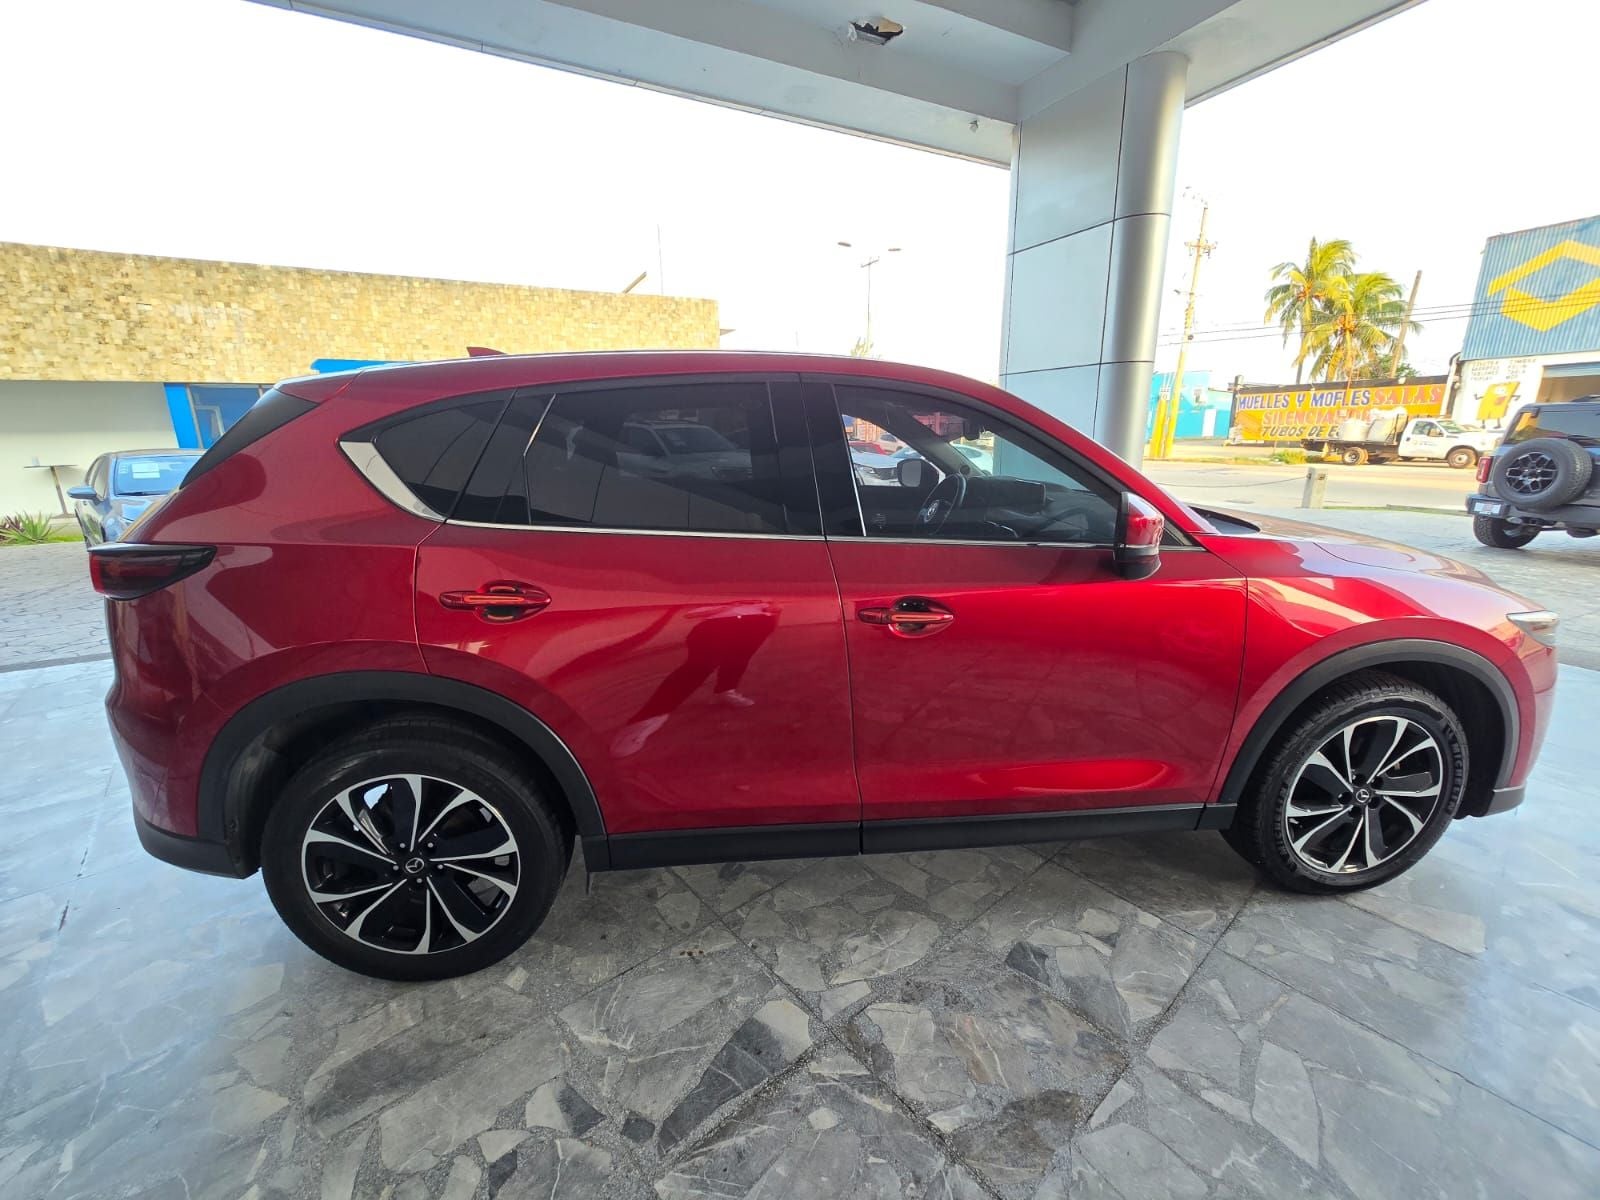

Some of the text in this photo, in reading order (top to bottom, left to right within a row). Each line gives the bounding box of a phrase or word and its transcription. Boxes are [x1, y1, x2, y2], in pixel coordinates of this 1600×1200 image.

[1239, 385, 1442, 409] MUELLES Y MOFLES SALAS
[1262, 425, 1306, 437] TUBOS
[1308, 425, 1326, 437] DE
[1447, 742, 1464, 812] MICHELIN
